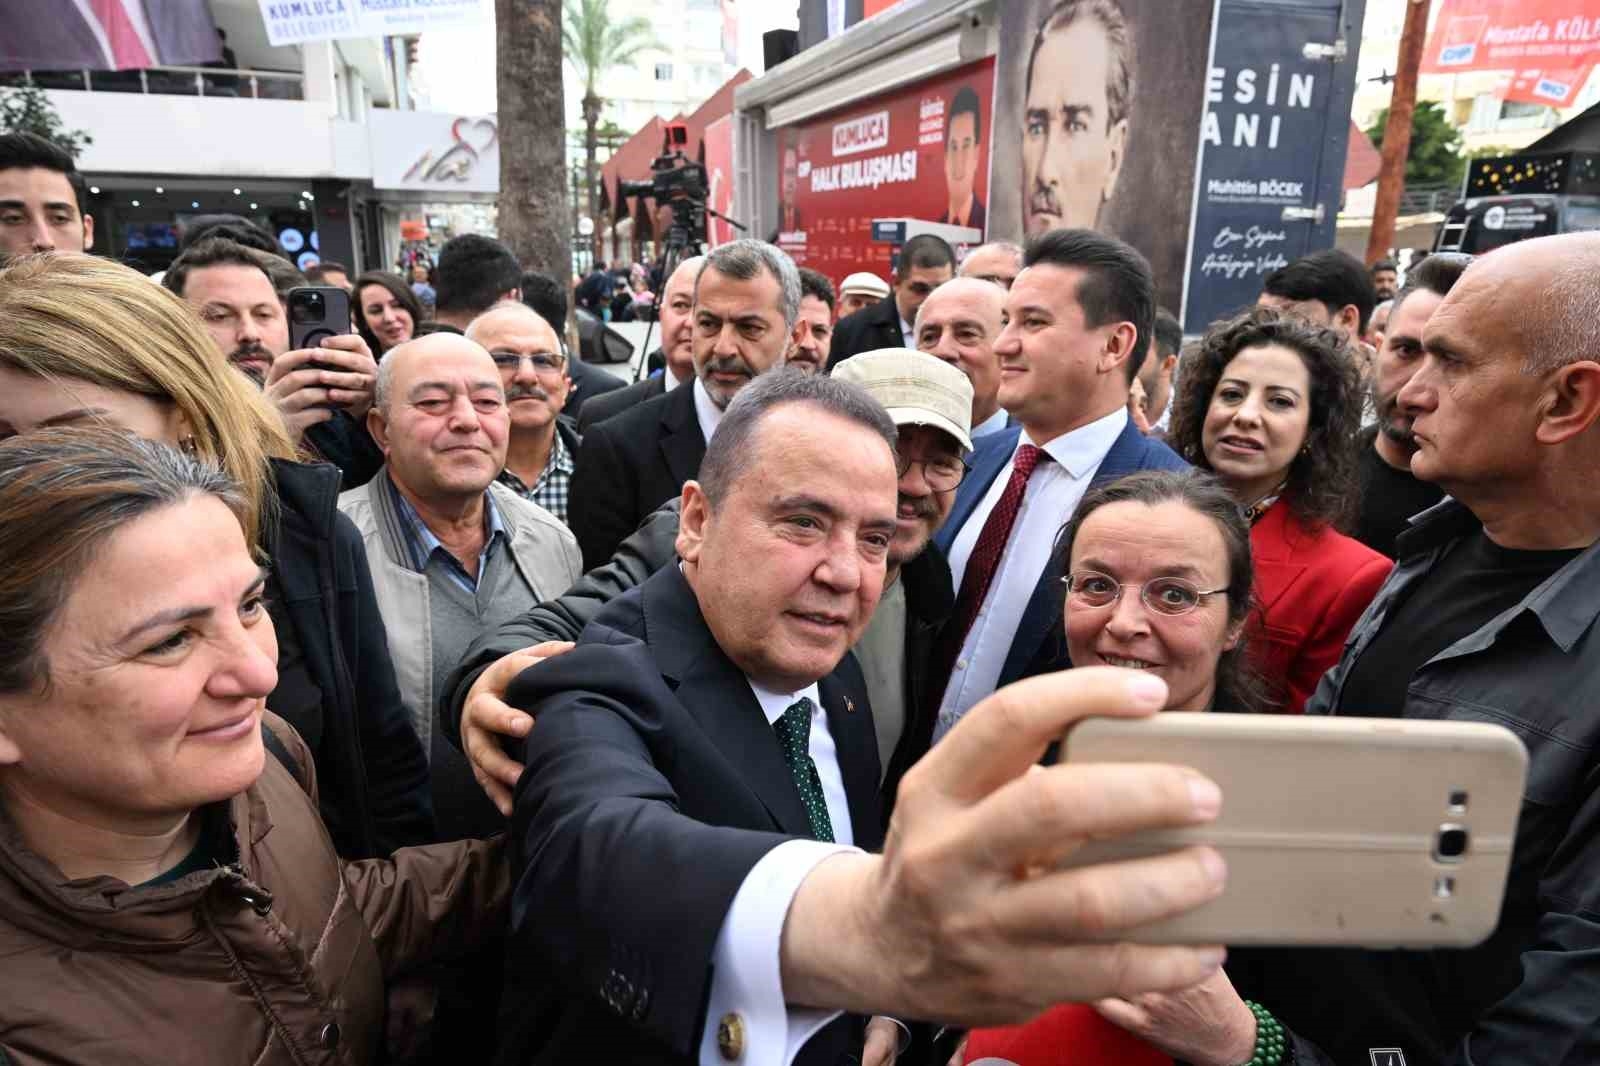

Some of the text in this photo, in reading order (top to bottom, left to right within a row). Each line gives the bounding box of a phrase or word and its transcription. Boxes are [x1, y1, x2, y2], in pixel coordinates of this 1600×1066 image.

[269, 0, 345, 20] KUMLUCA
[1484, 20, 1549, 43] Mustafa
[835, 118, 885, 149] KUMLUCA
[811, 150, 918, 193] HALK BULUŞMASI
[1207, 179, 1304, 197] Muhittin BÖCEK
